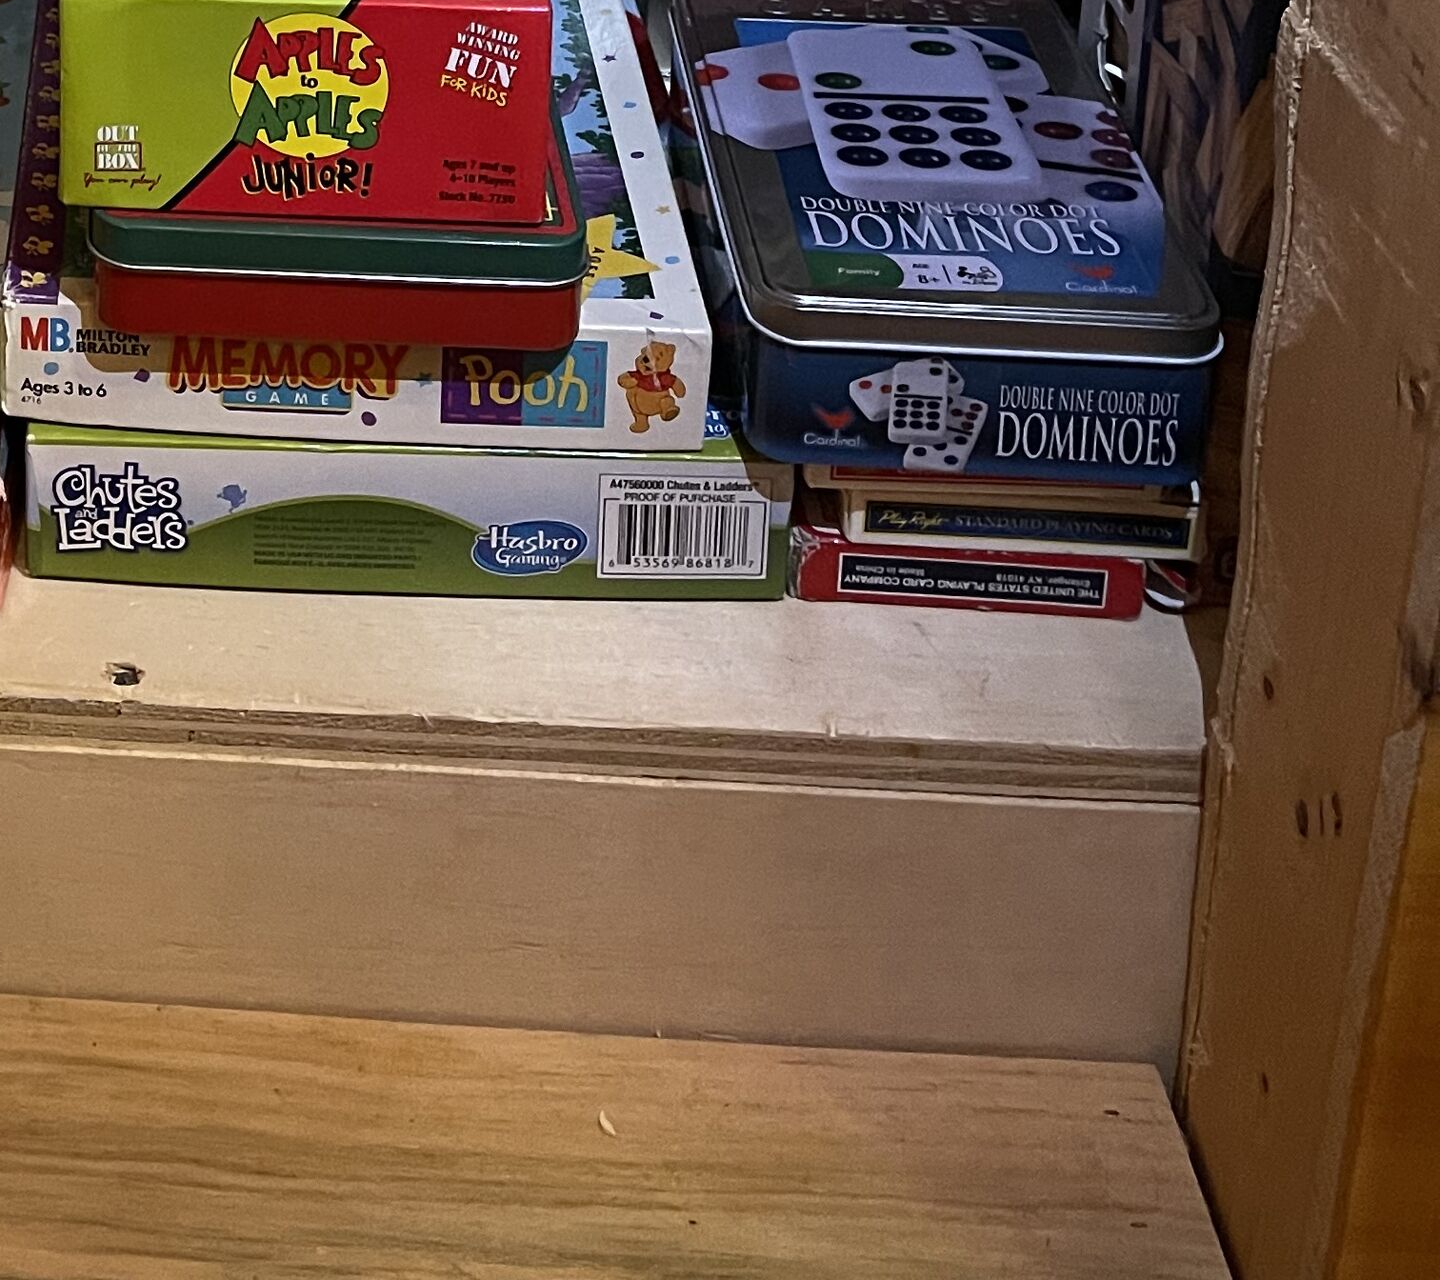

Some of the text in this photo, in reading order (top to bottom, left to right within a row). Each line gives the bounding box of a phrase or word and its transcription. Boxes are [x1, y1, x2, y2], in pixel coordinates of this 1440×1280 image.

[456, 31, 521, 62] WINNING
[465, 21, 520, 46] AWARD
[233, 16, 387, 86] APPLES
[300, 72, 318, 89] to
[444, 47, 519, 90] FUN
[440, 74, 509, 108] FOR KIDS
[234, 80, 383, 151] APPLES
[96, 125, 140, 142] OUT
[97, 153, 140, 170] BOX
[241, 153, 374, 202] JUNIOR!
[799, 195, 892, 215] DOUBLE
[1049, 203, 1104, 220] DOT
[807, 210, 1122, 258] DOMINOES
[20, 317, 71, 352] MB
[75, 329, 141, 344] MILTON
[74, 341, 151, 358] BRADLEY
[166, 336, 411, 398] MEMORY
[20, 378, 108, 398] Ages to 6
[245, 390, 330, 406] GAME
[460, 355, 589, 413] Pooh
[20, 395, 42, 405] 4716
[999, 384, 1181, 418] DOUBLE NINE COLOR DOT
[803, 428, 862, 448] Cardinal
[995, 411, 1179, 468] DOMINOES
[54, 466, 179, 512] Chutes
[623, 492, 736, 505] PROOF OF PURCHASE
[57, 508, 187, 552] Ladders
[478, 526, 579, 554] Hasbro
[953, 513, 1174, 541] STANDARD PLAYING CARDS
[495, 549, 562, 570] Gaming
[633, 555, 733, 569] 53569 86818
[844, 573, 1101, 601] THE UNITED STATES PLAYING CARD COMPANY
